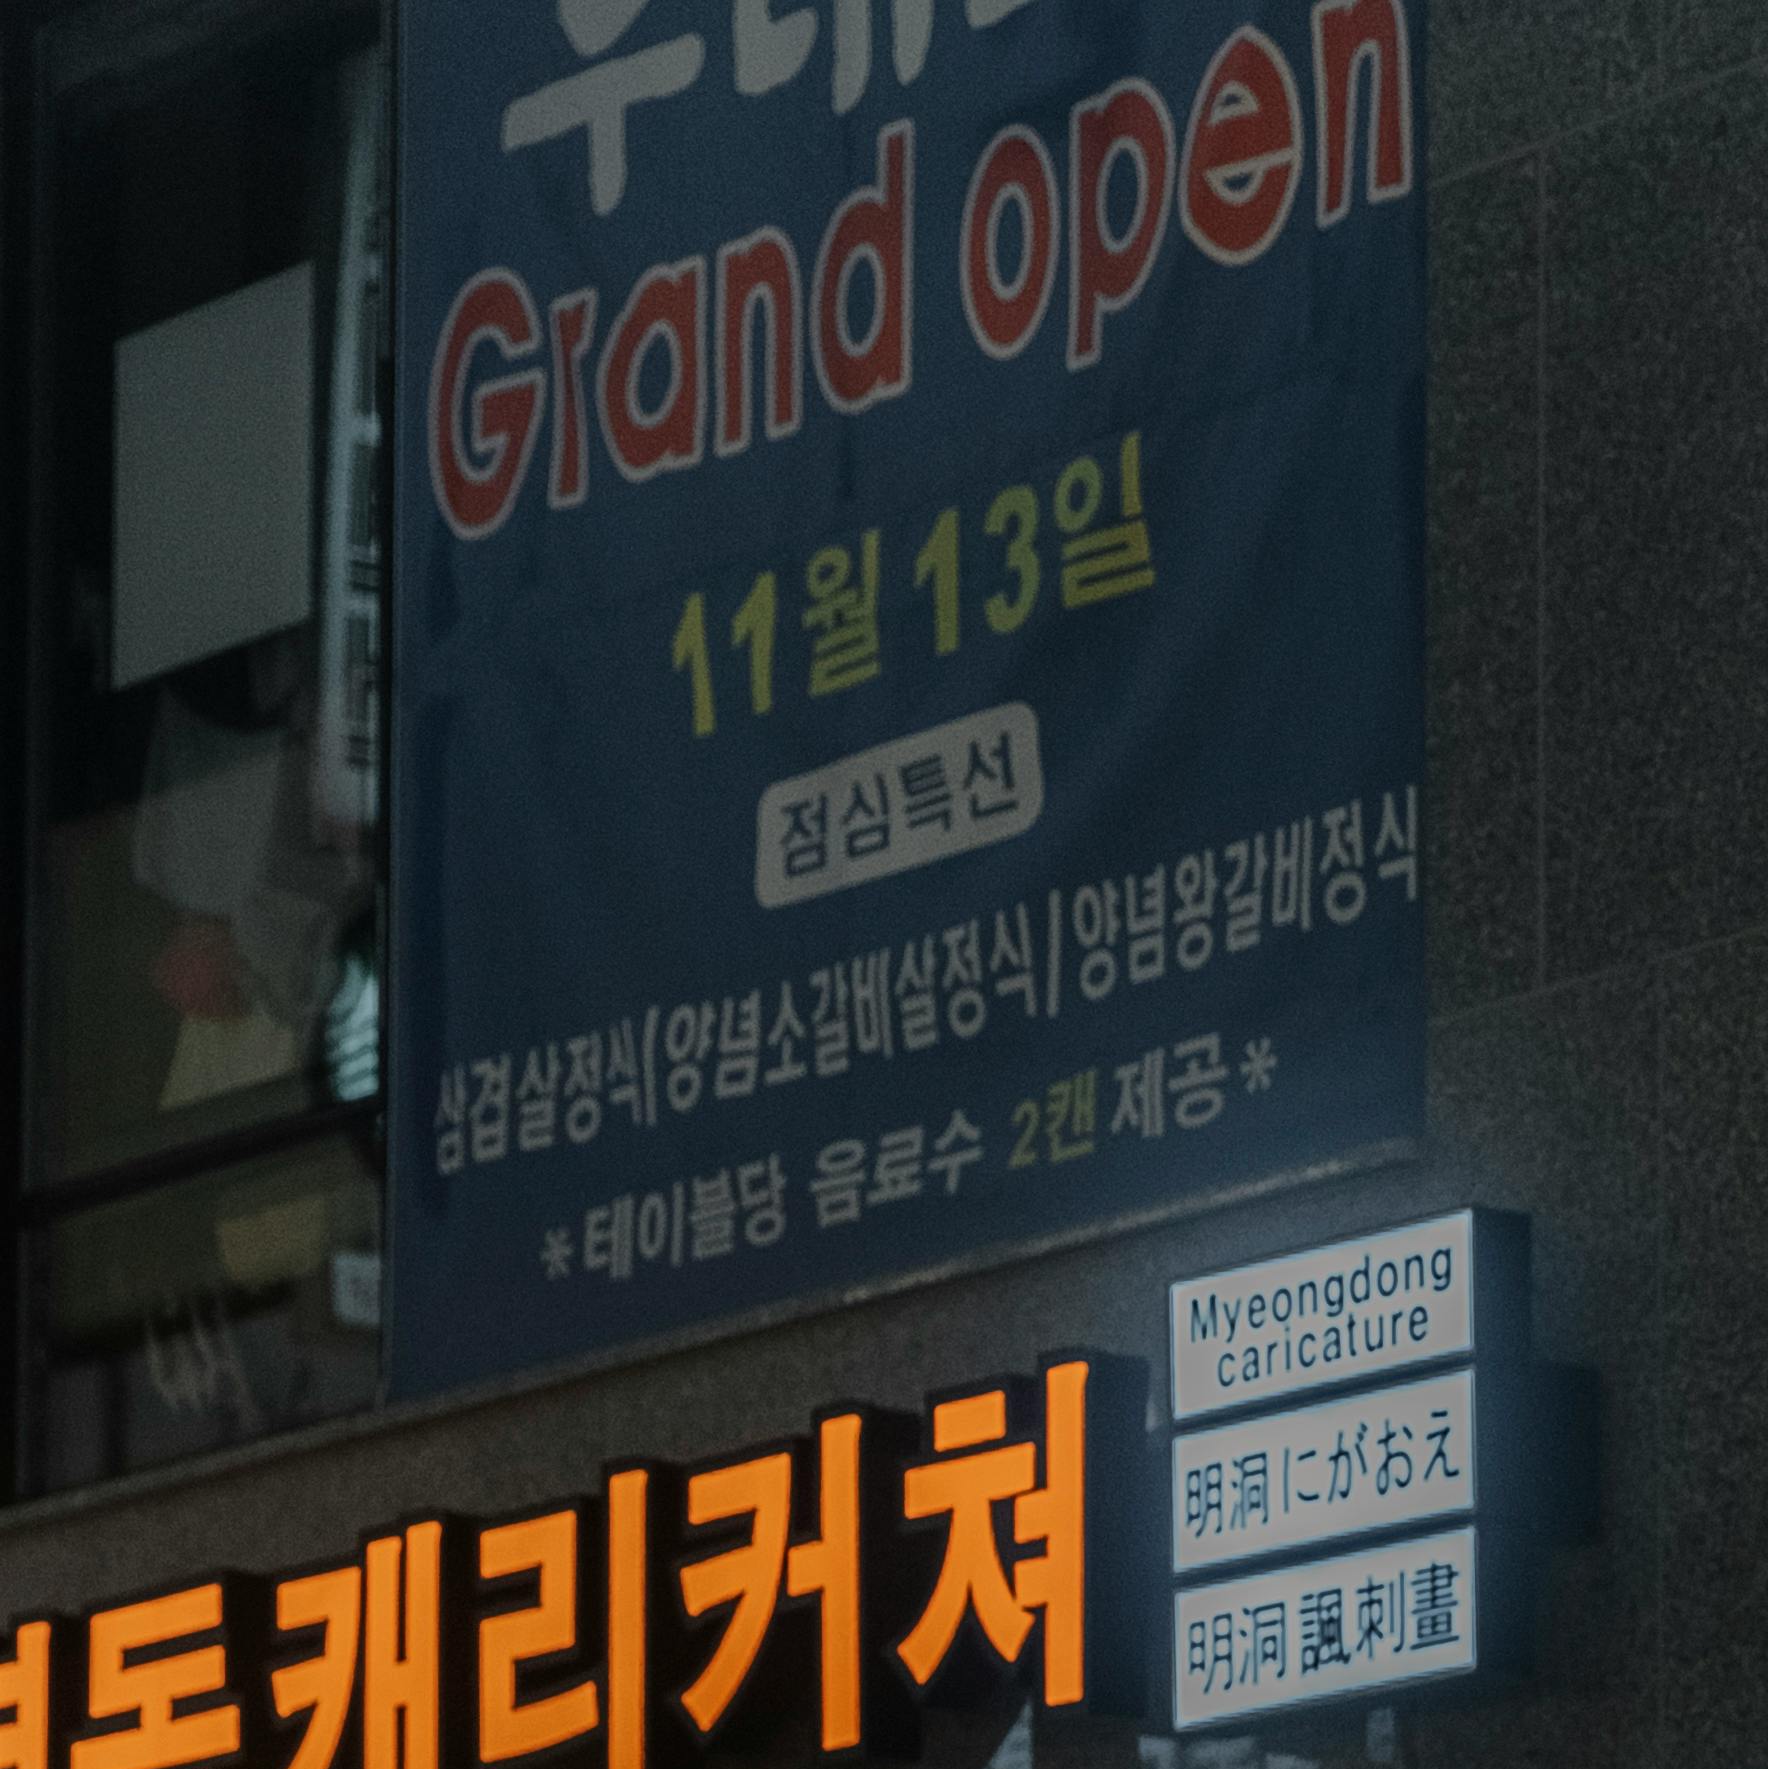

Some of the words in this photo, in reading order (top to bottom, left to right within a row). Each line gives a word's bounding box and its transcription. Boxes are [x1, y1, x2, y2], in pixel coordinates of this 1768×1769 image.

[429, 118, 915, 540] Grand
[958, 0, 1412, 371] open
[672, 528, 882, 738] 11월
[913, 431, 1156, 656] 13일
[777, 730, 1019, 880] 점심특선
[809, 1109, 984, 1226] 음료수
[1009, 1069, 1097, 1171] 2캔
[1189, 1247, 1454, 1345] Myeongdong
[1217, 1303, 1430, 1388] caricature
[1186, 1409, 1461, 1538] 明洞にがおえ
